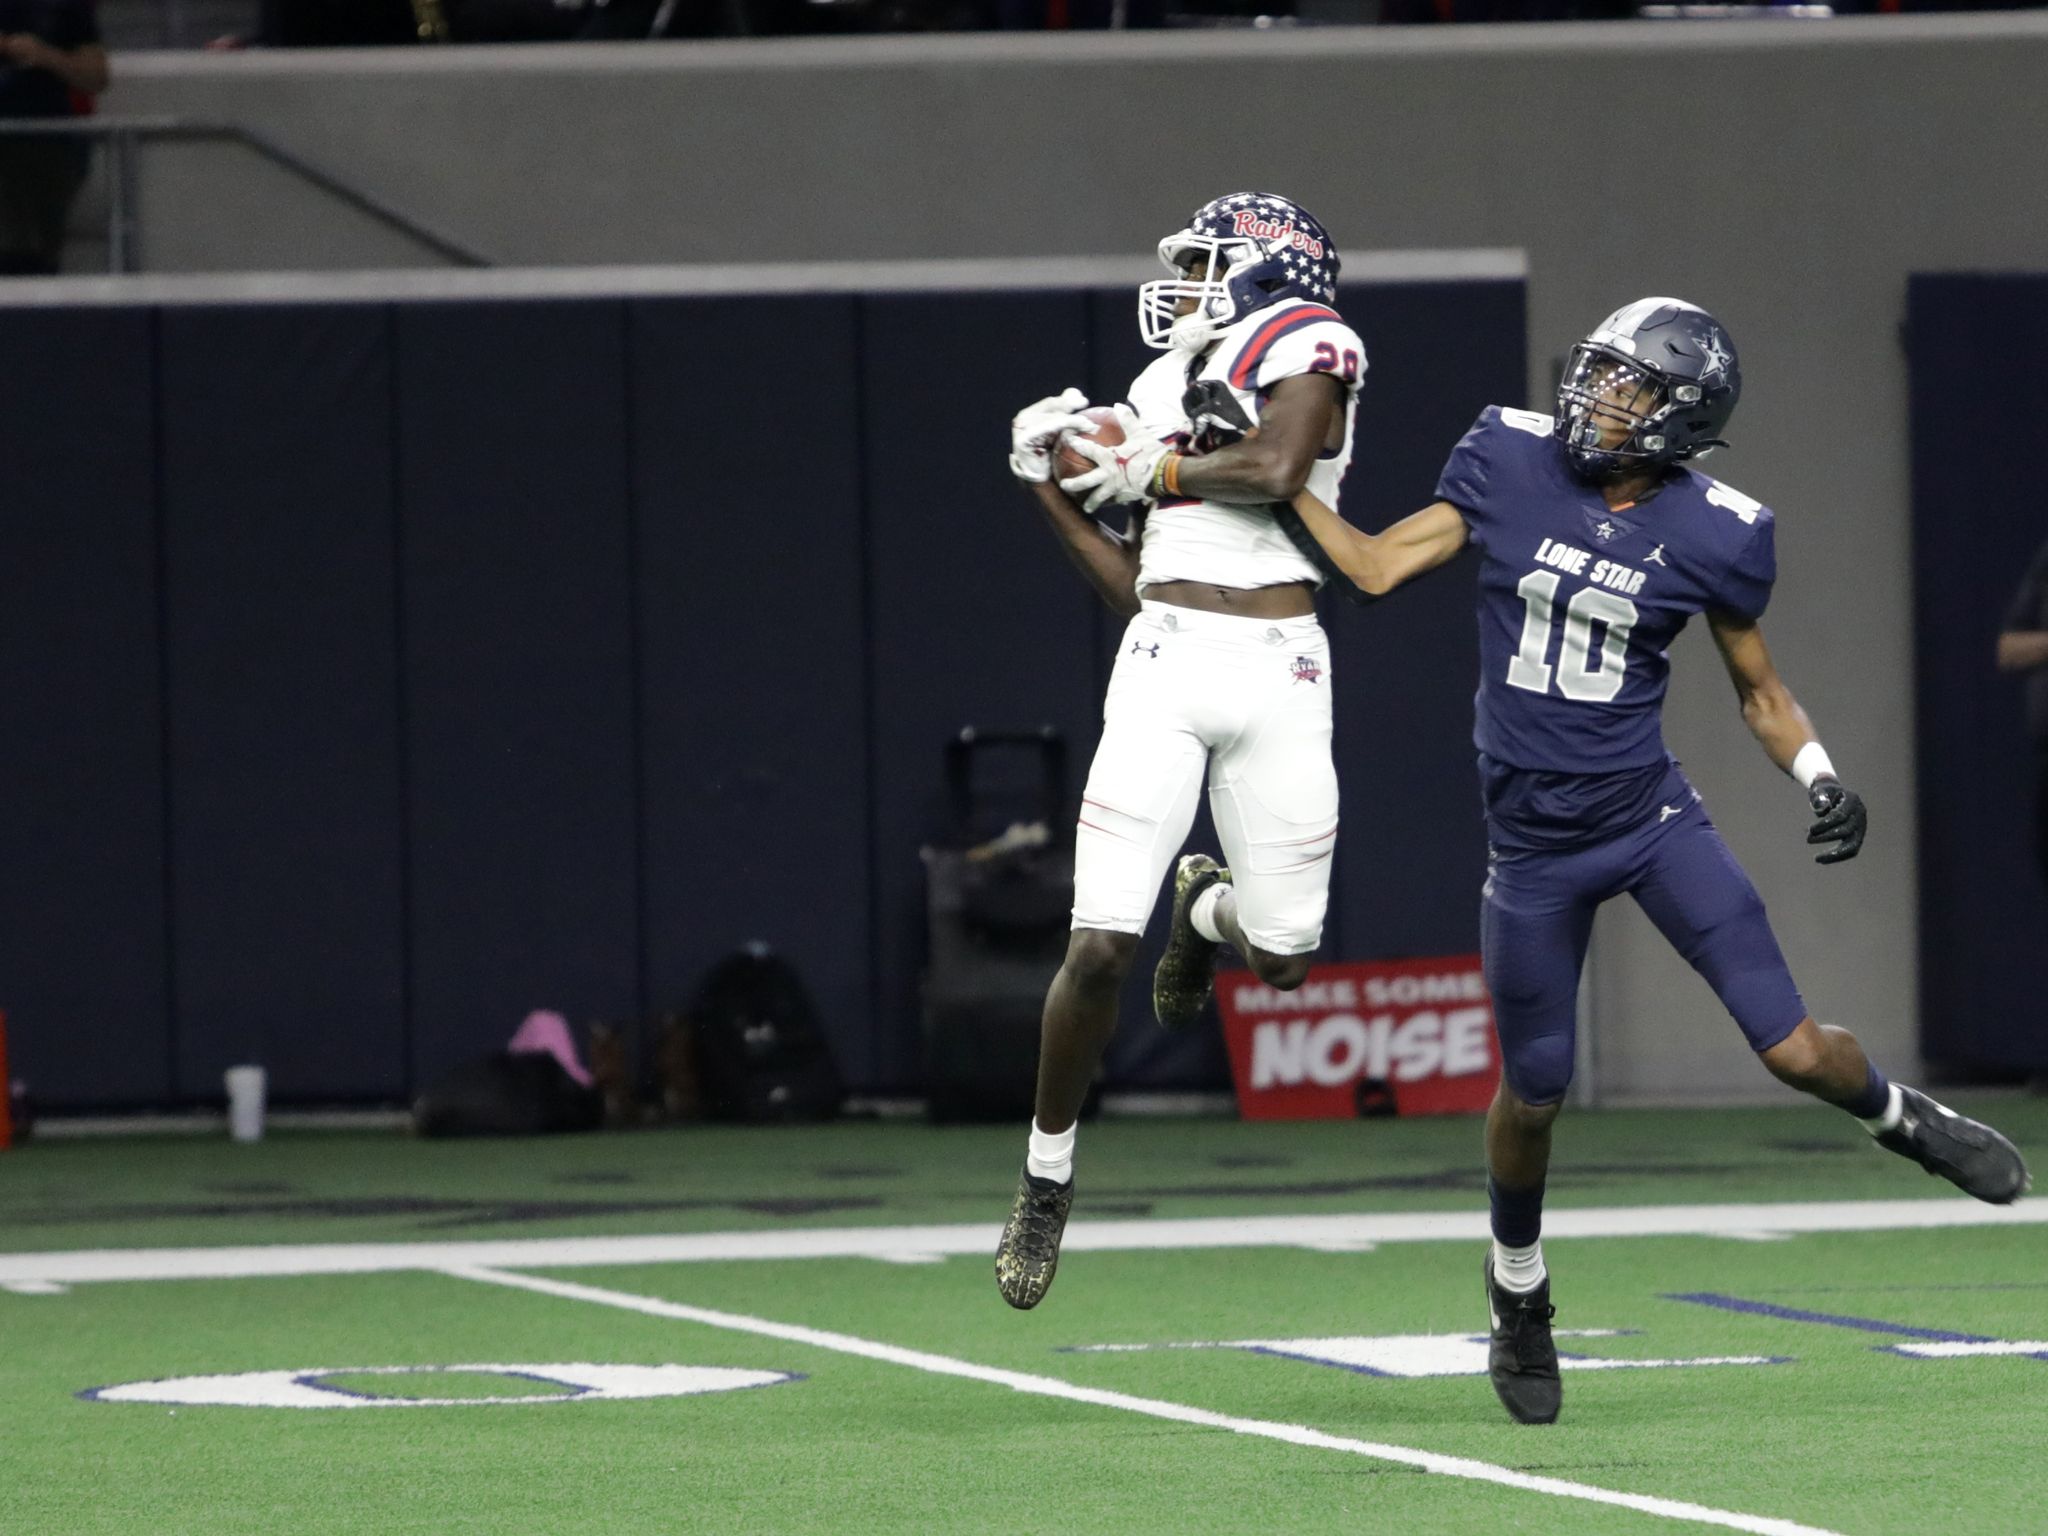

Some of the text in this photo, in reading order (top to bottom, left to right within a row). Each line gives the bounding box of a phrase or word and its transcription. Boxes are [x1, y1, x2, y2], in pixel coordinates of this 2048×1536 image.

[1233, 210, 1324, 260] Raiders
[1534, 537, 1647, 596] LONE STAR
[1506, 568, 1640, 702] 10
[1234, 968, 1488, 1015] MAKE SOME
[1251, 1007, 1492, 1090] NOISE
